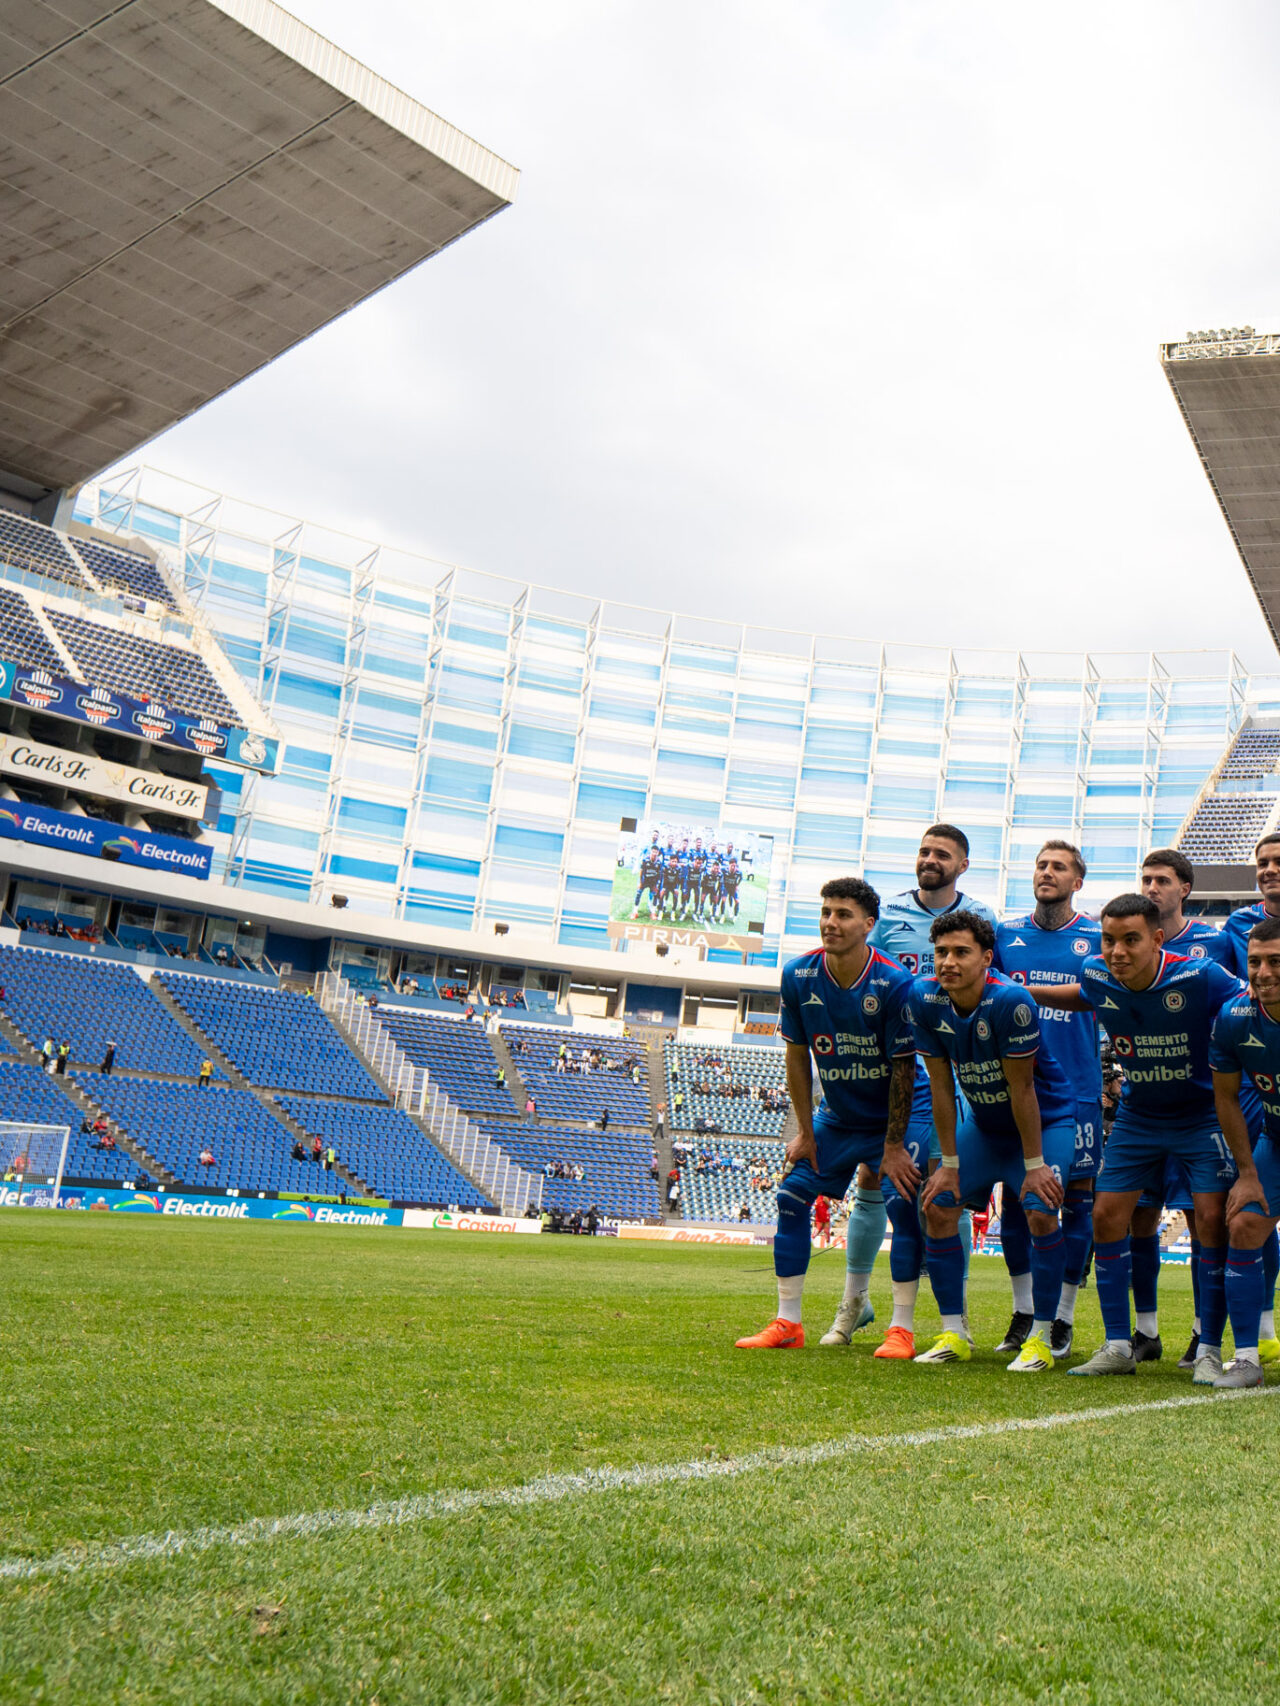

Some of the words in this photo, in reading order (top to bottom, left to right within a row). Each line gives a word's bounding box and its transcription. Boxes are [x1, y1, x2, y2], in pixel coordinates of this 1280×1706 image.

[11, 746, 61, 773] Carl's
[63, 760, 88, 780] Jr.
[129, 777, 177, 801] Carl's
[176, 788, 199, 808] Jr.
[22, 816, 95, 844] Electrolit
[141, 843, 208, 869] Electrolit
[624, 925, 710, 948] PIRMA
[1030, 970, 1077, 984] CEMENTO
[1038, 1006, 1073, 1023] ibet
[1134, 1032, 1189, 1046] CEMENTO
[1136, 1048, 1164, 1058] CRUZ
[1165, 1046, 1190, 1058] AZUL
[819, 1063, 890, 1082] novibet
[1123, 1063, 1193, 1083] novibet
[1075, 1122, 1094, 1149] 33
[162, 1198, 249, 1218] Electrolit
[314, 1207, 388, 1226] Electrolit
[457, 1218, 517, 1233] Castrol
